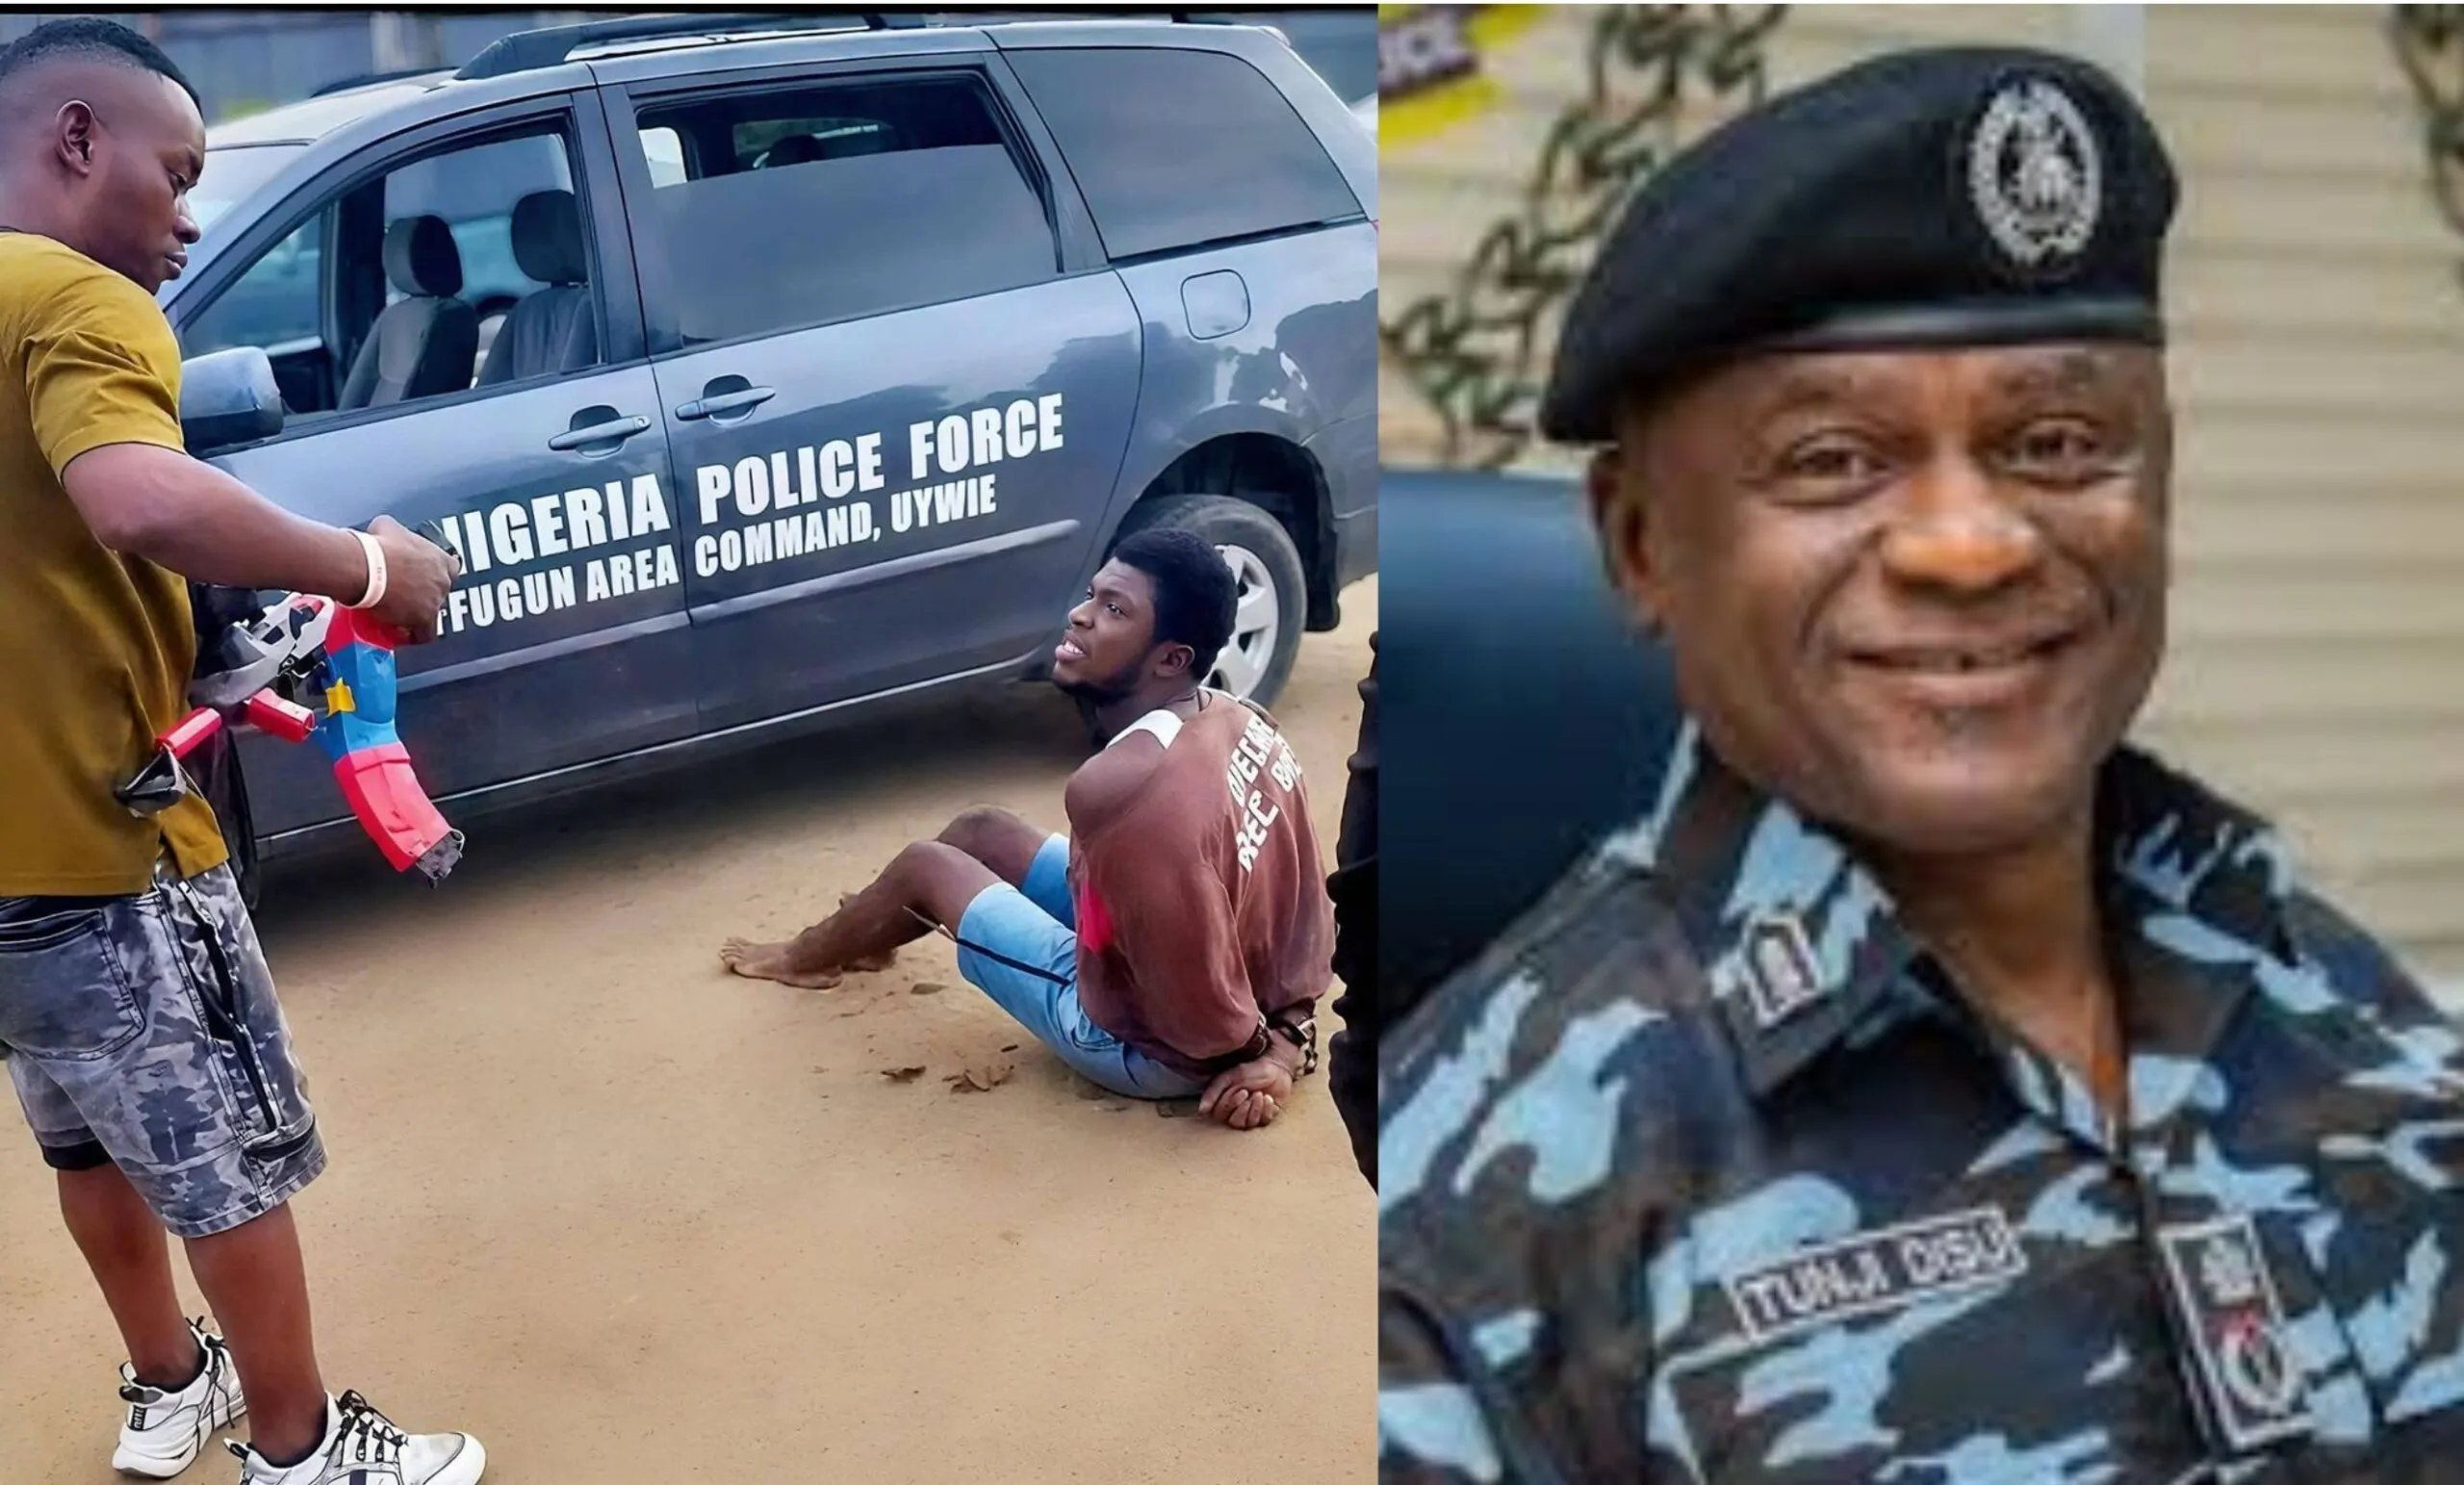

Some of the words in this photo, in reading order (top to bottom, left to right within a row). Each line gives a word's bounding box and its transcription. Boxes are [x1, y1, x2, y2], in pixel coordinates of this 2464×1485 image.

[696, 432, 885, 525] POLICE
[910, 393, 1064, 480] FORCE
[586, 545, 680, 602] AREA
[694, 501, 882, 577] COMMAND,
[890, 474, 997, 533] UYWIE
[1740, 1249, 1889, 1321] TUNJI
